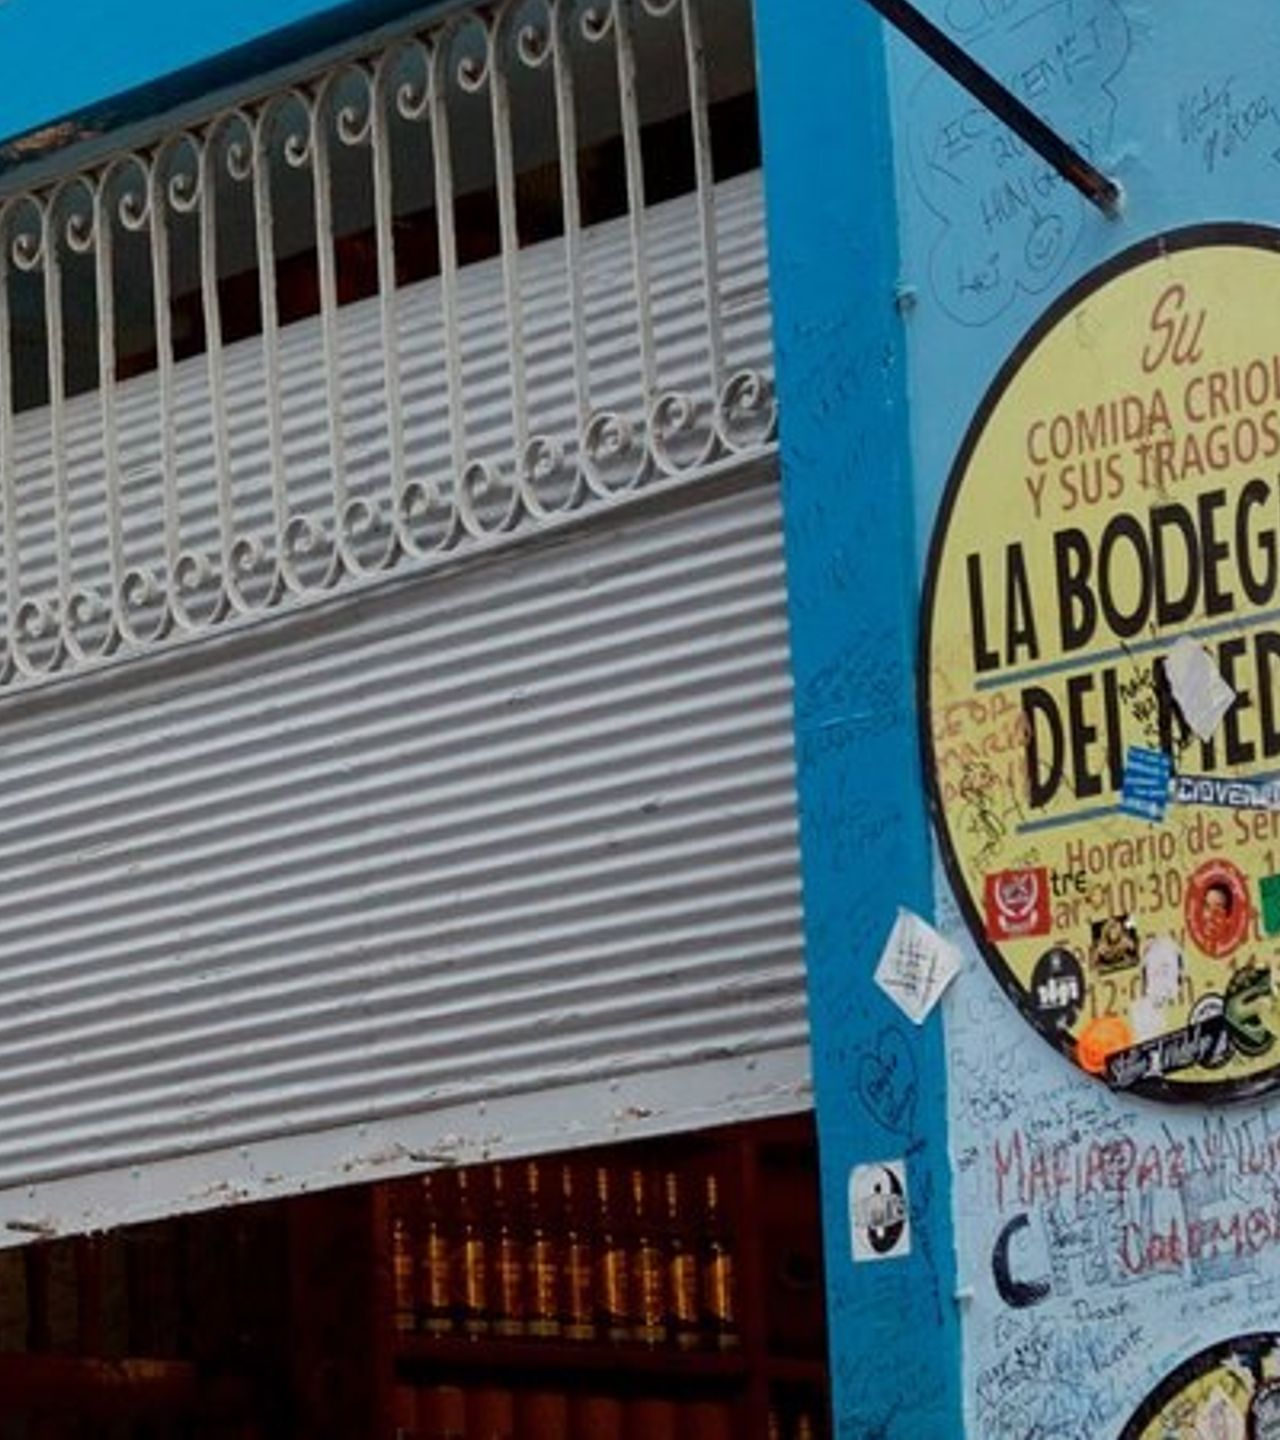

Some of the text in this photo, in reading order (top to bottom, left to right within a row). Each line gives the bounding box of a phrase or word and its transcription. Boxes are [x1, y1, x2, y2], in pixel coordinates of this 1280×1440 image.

[1142, 284, 1207, 373] Su
[1025, 410, 1280, 518] Y SUS TRAGOS
[1026, 389, 1171, 467] COMIDA
[966, 541, 1040, 673] LA
[1021, 668, 1125, 810] DEL
[1066, 821, 1176, 876] Horario
[1187, 811, 1224, 856] de
